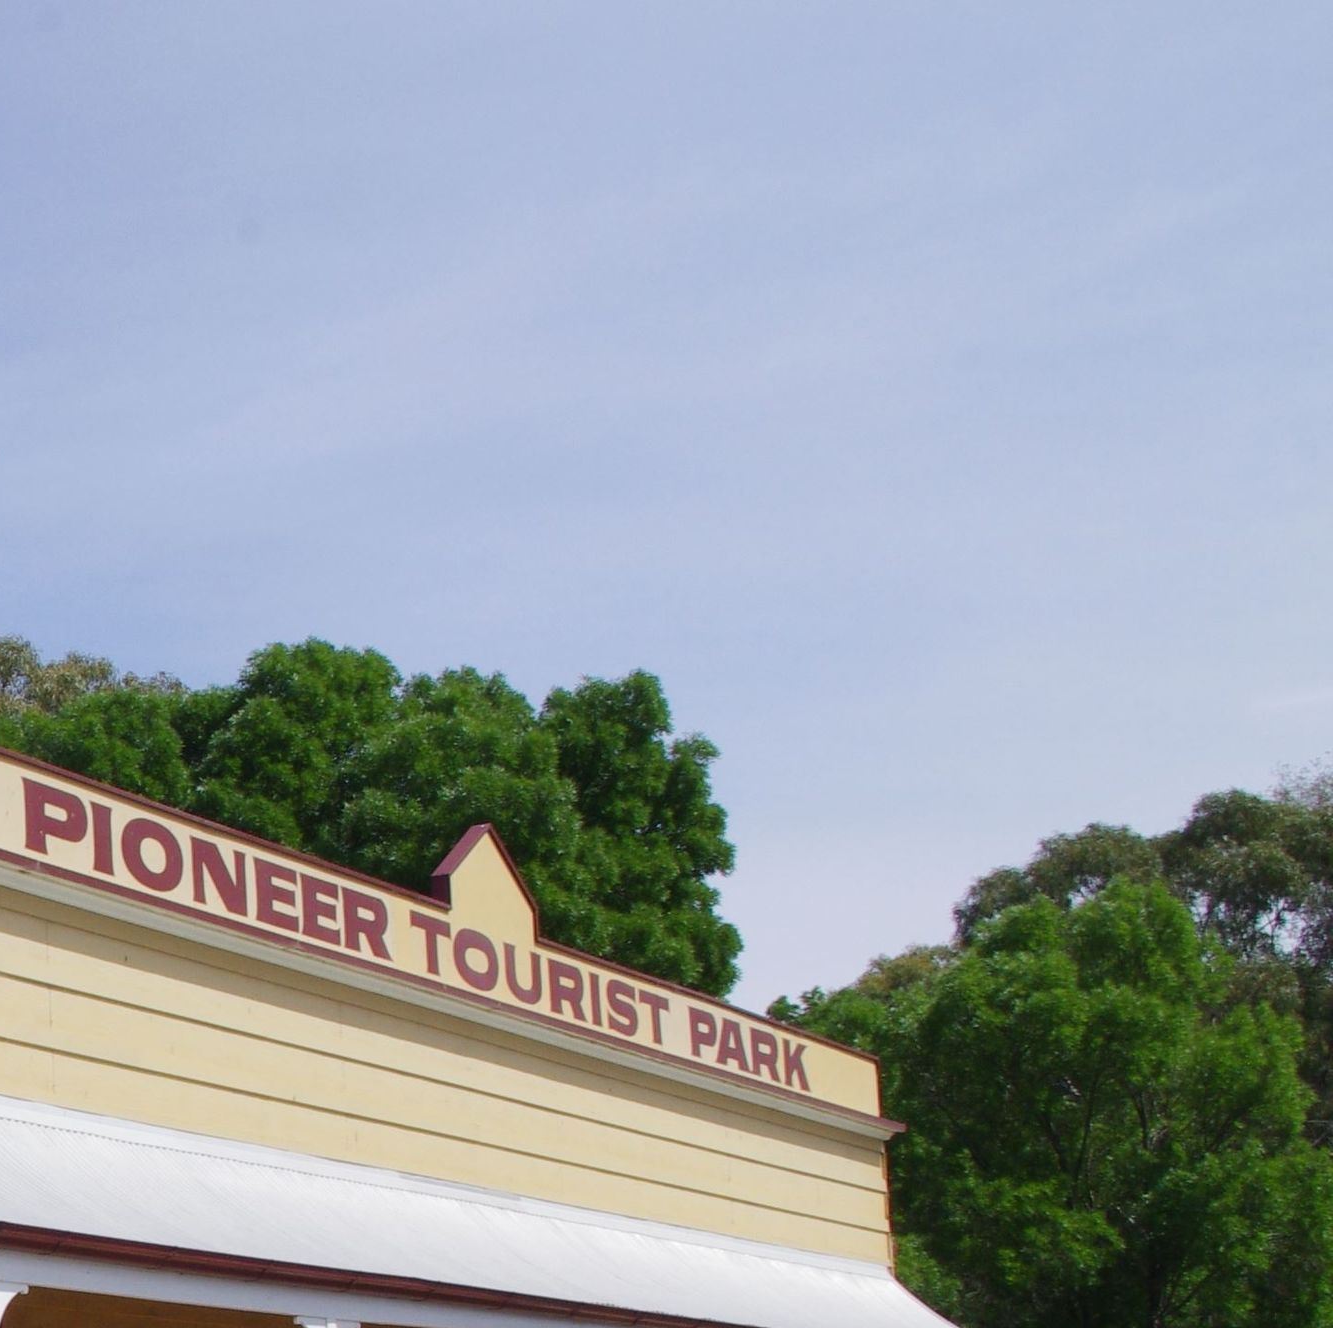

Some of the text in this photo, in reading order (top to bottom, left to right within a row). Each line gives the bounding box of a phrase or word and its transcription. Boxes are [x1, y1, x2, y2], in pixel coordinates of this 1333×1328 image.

[21, 777, 810, 1091] PIONEER TOURIST PARK
